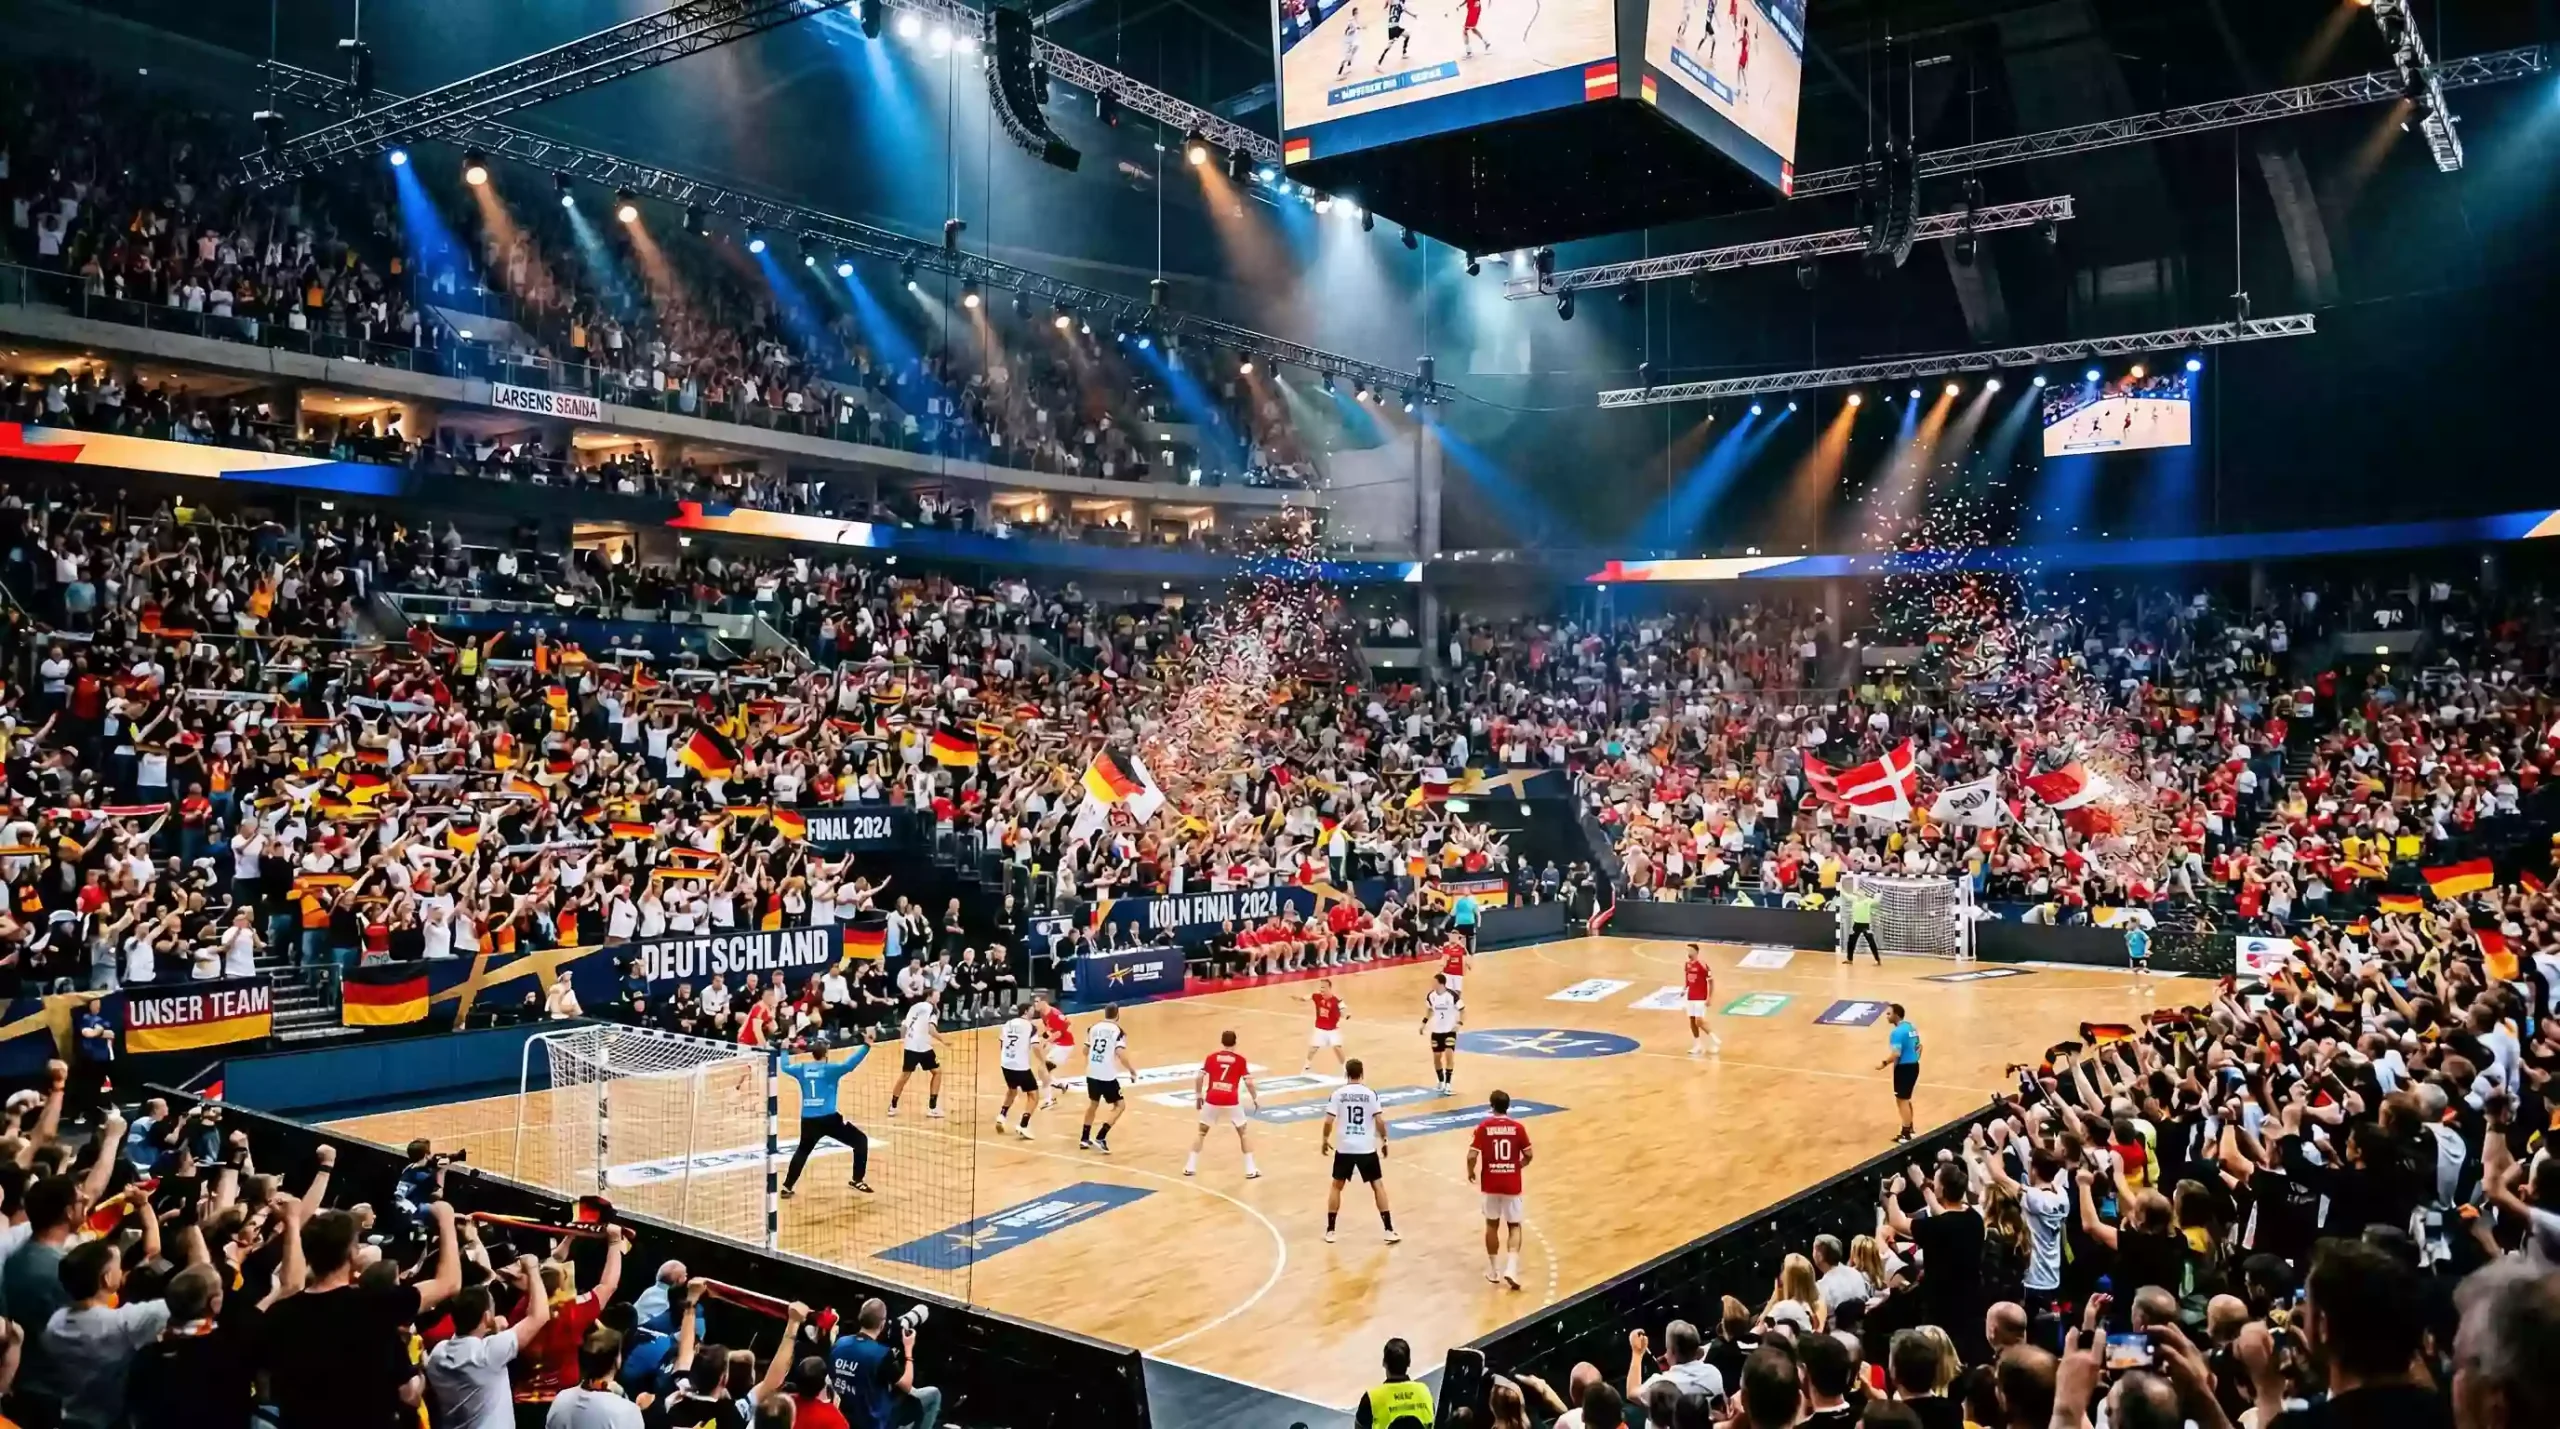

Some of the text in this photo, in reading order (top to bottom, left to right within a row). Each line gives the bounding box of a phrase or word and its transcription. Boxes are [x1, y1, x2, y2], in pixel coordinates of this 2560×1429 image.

[495, 386, 553, 412] LARSENS
[807, 816, 892, 841] FINAL 2024
[1150, 891, 1278, 929] KÖLN FINAL 2024
[642, 929, 829, 982] DEUTSCHLAND
[129, 985, 269, 1027] UNSER TEAM
[1220, 1063, 1231, 1082] 7
[810, 1079, 816, 1099] 1
[1492, 1138, 1511, 1161] 10
